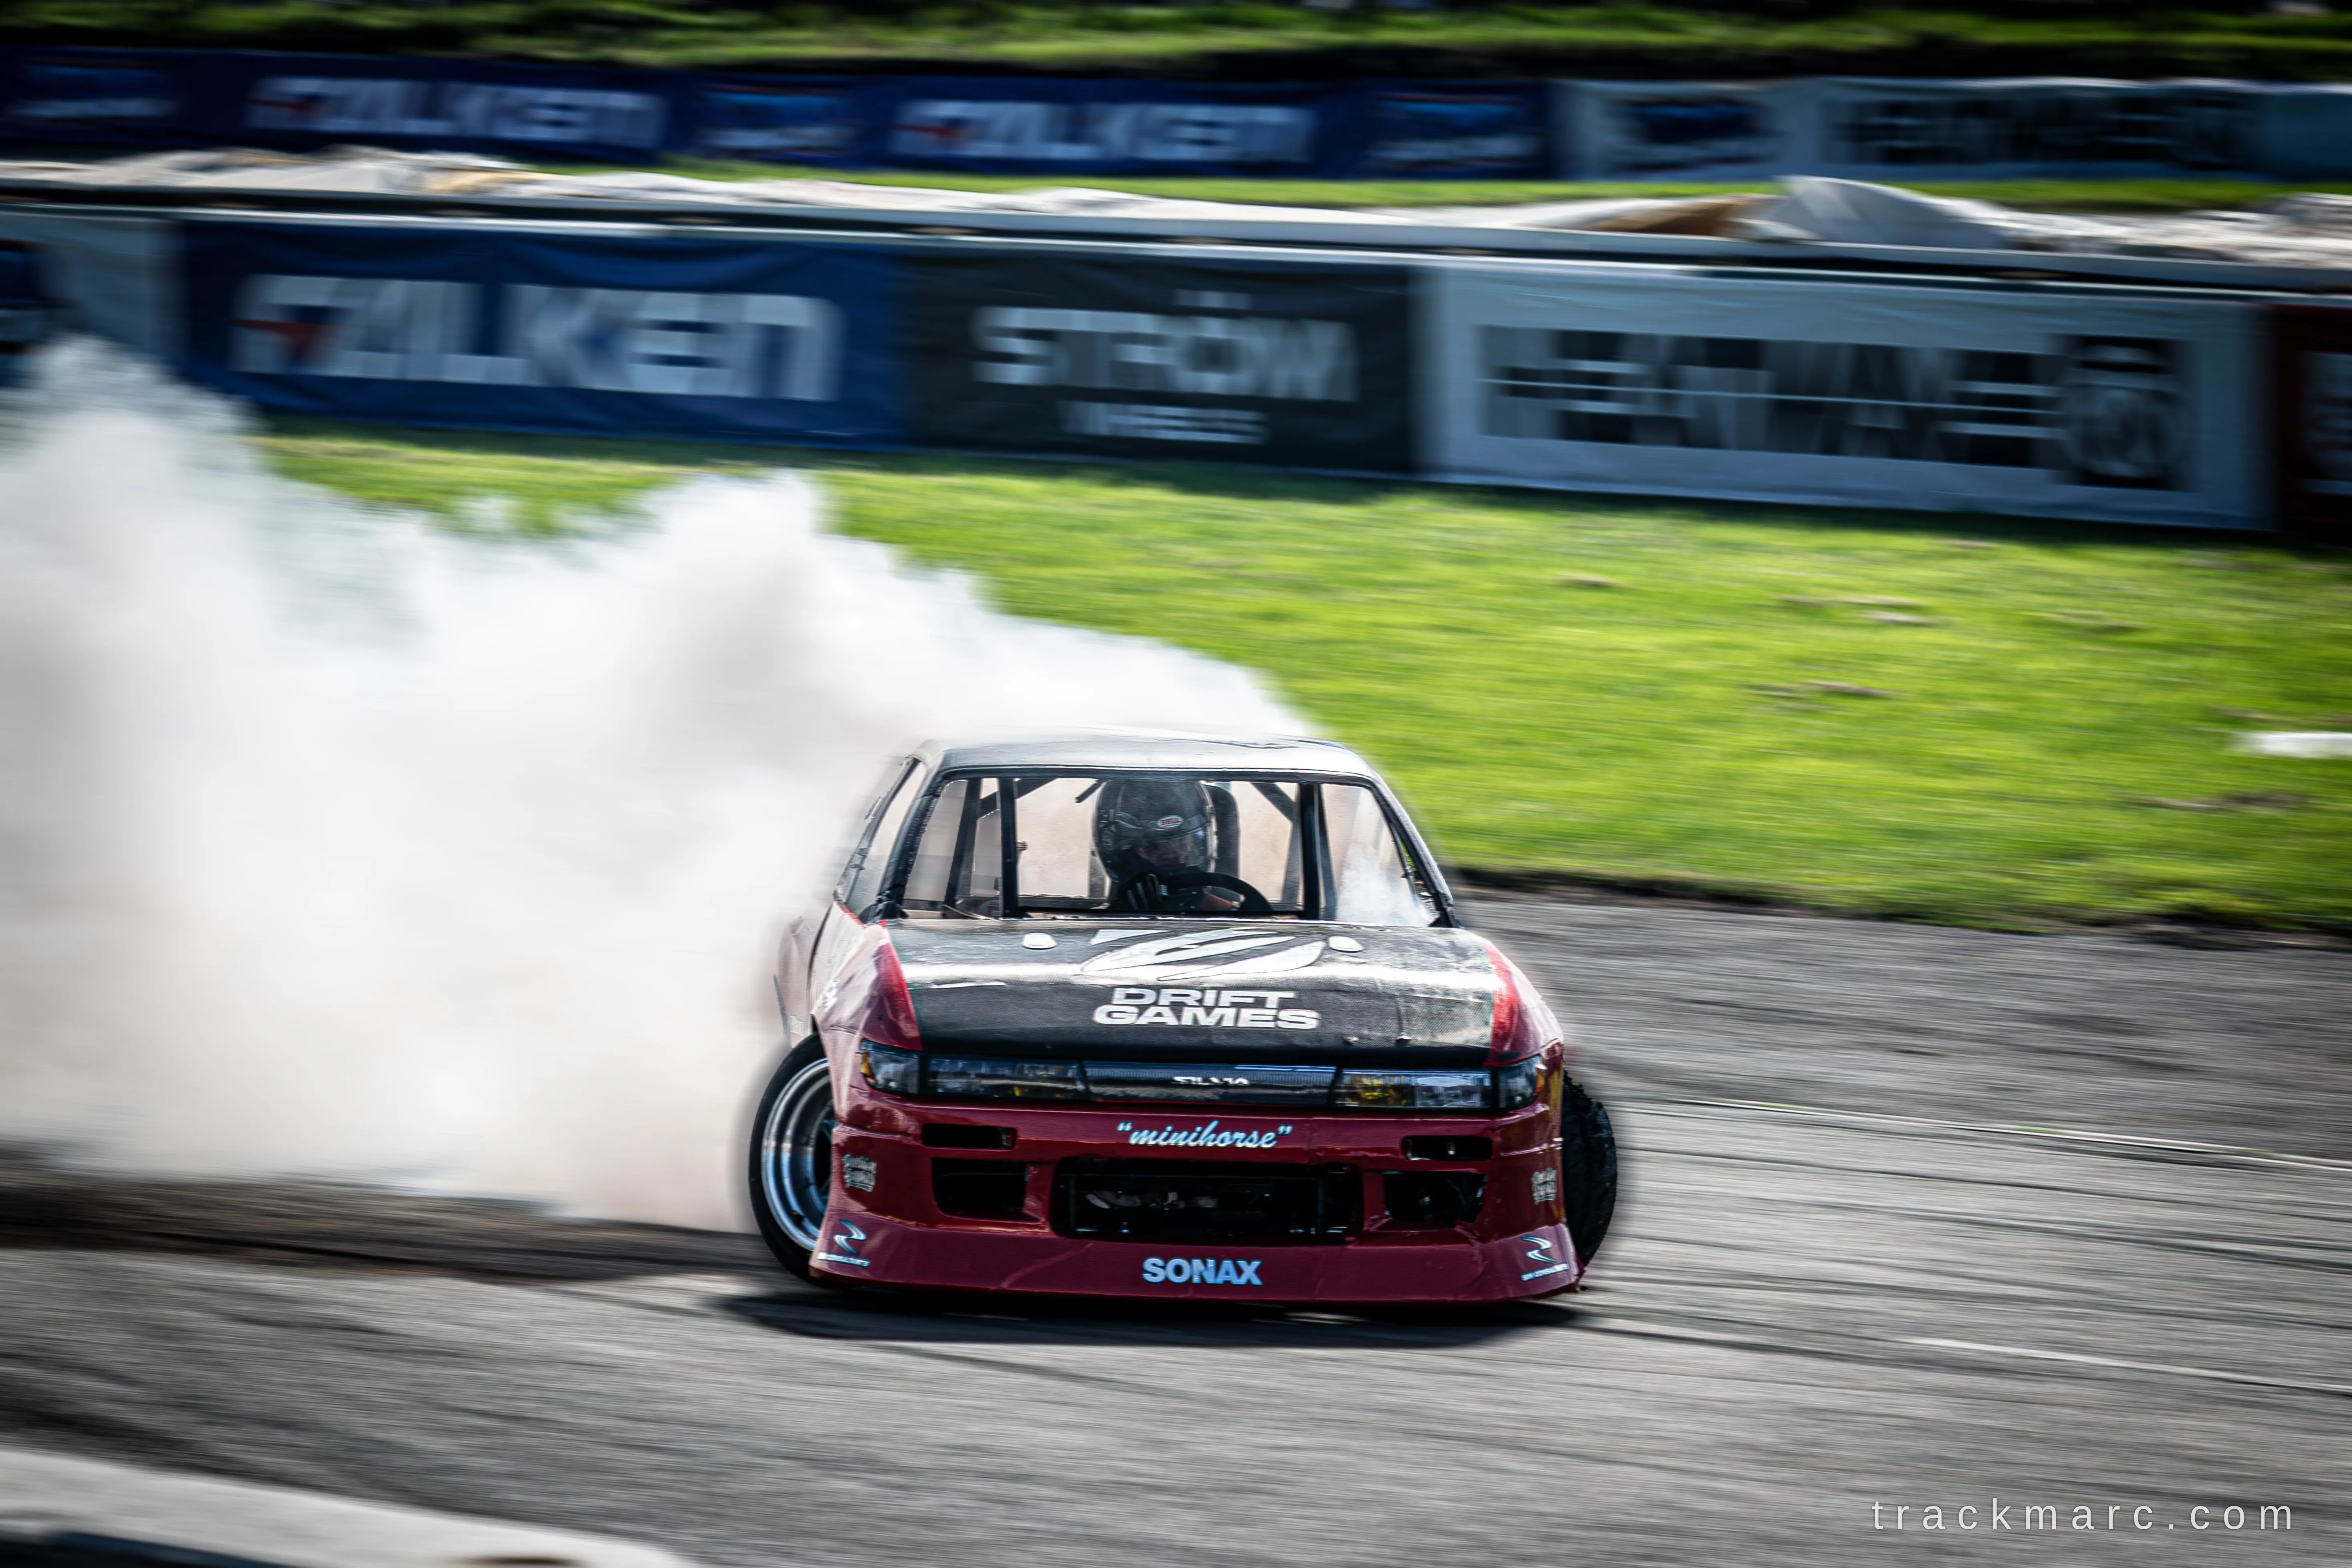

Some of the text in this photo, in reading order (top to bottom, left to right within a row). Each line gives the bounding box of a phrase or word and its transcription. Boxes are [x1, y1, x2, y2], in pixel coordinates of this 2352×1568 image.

[228, 273, 846, 401] FALKEN
[1111, 987, 1298, 1009] DRIFT
[1092, 1004, 1322, 1030] GAMES
[1141, 1257, 1263, 1286] SONAX
